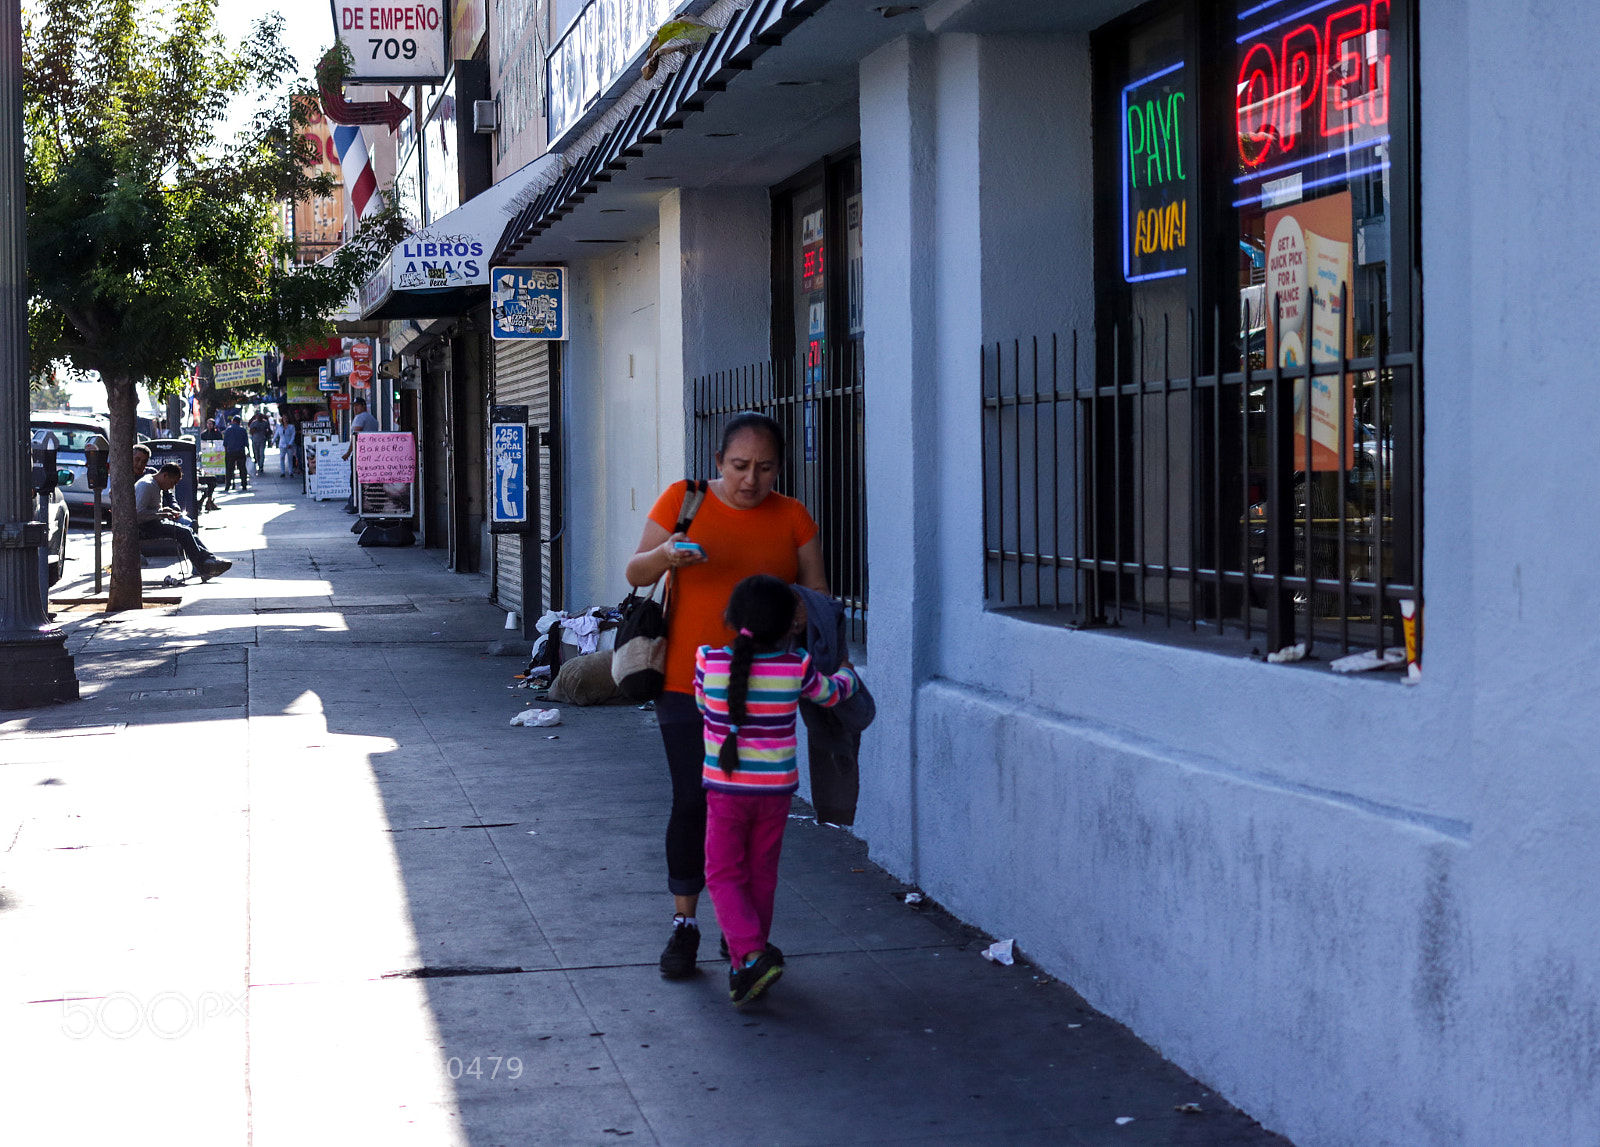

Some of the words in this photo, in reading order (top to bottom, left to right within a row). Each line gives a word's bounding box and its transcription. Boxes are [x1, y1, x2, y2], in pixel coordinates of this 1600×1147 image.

[343, 8, 364, 30] DE
[370, 4, 439, 30] EMPEÑO
[368, 38, 417, 60] 709
[404, 242, 483, 257] LIBROS
[1278, 237, 1290, 251] GET
[1291, 236, 1296, 249] A
[405, 260, 480, 278] ANA'S
[1270, 253, 1288, 271] QUICK
[1288, 251, 1303, 267] PICK
[1278, 272, 1290, 286] FOR
[1291, 270, 1296, 283] A
[215, 359, 262, 373] BOTANICA
